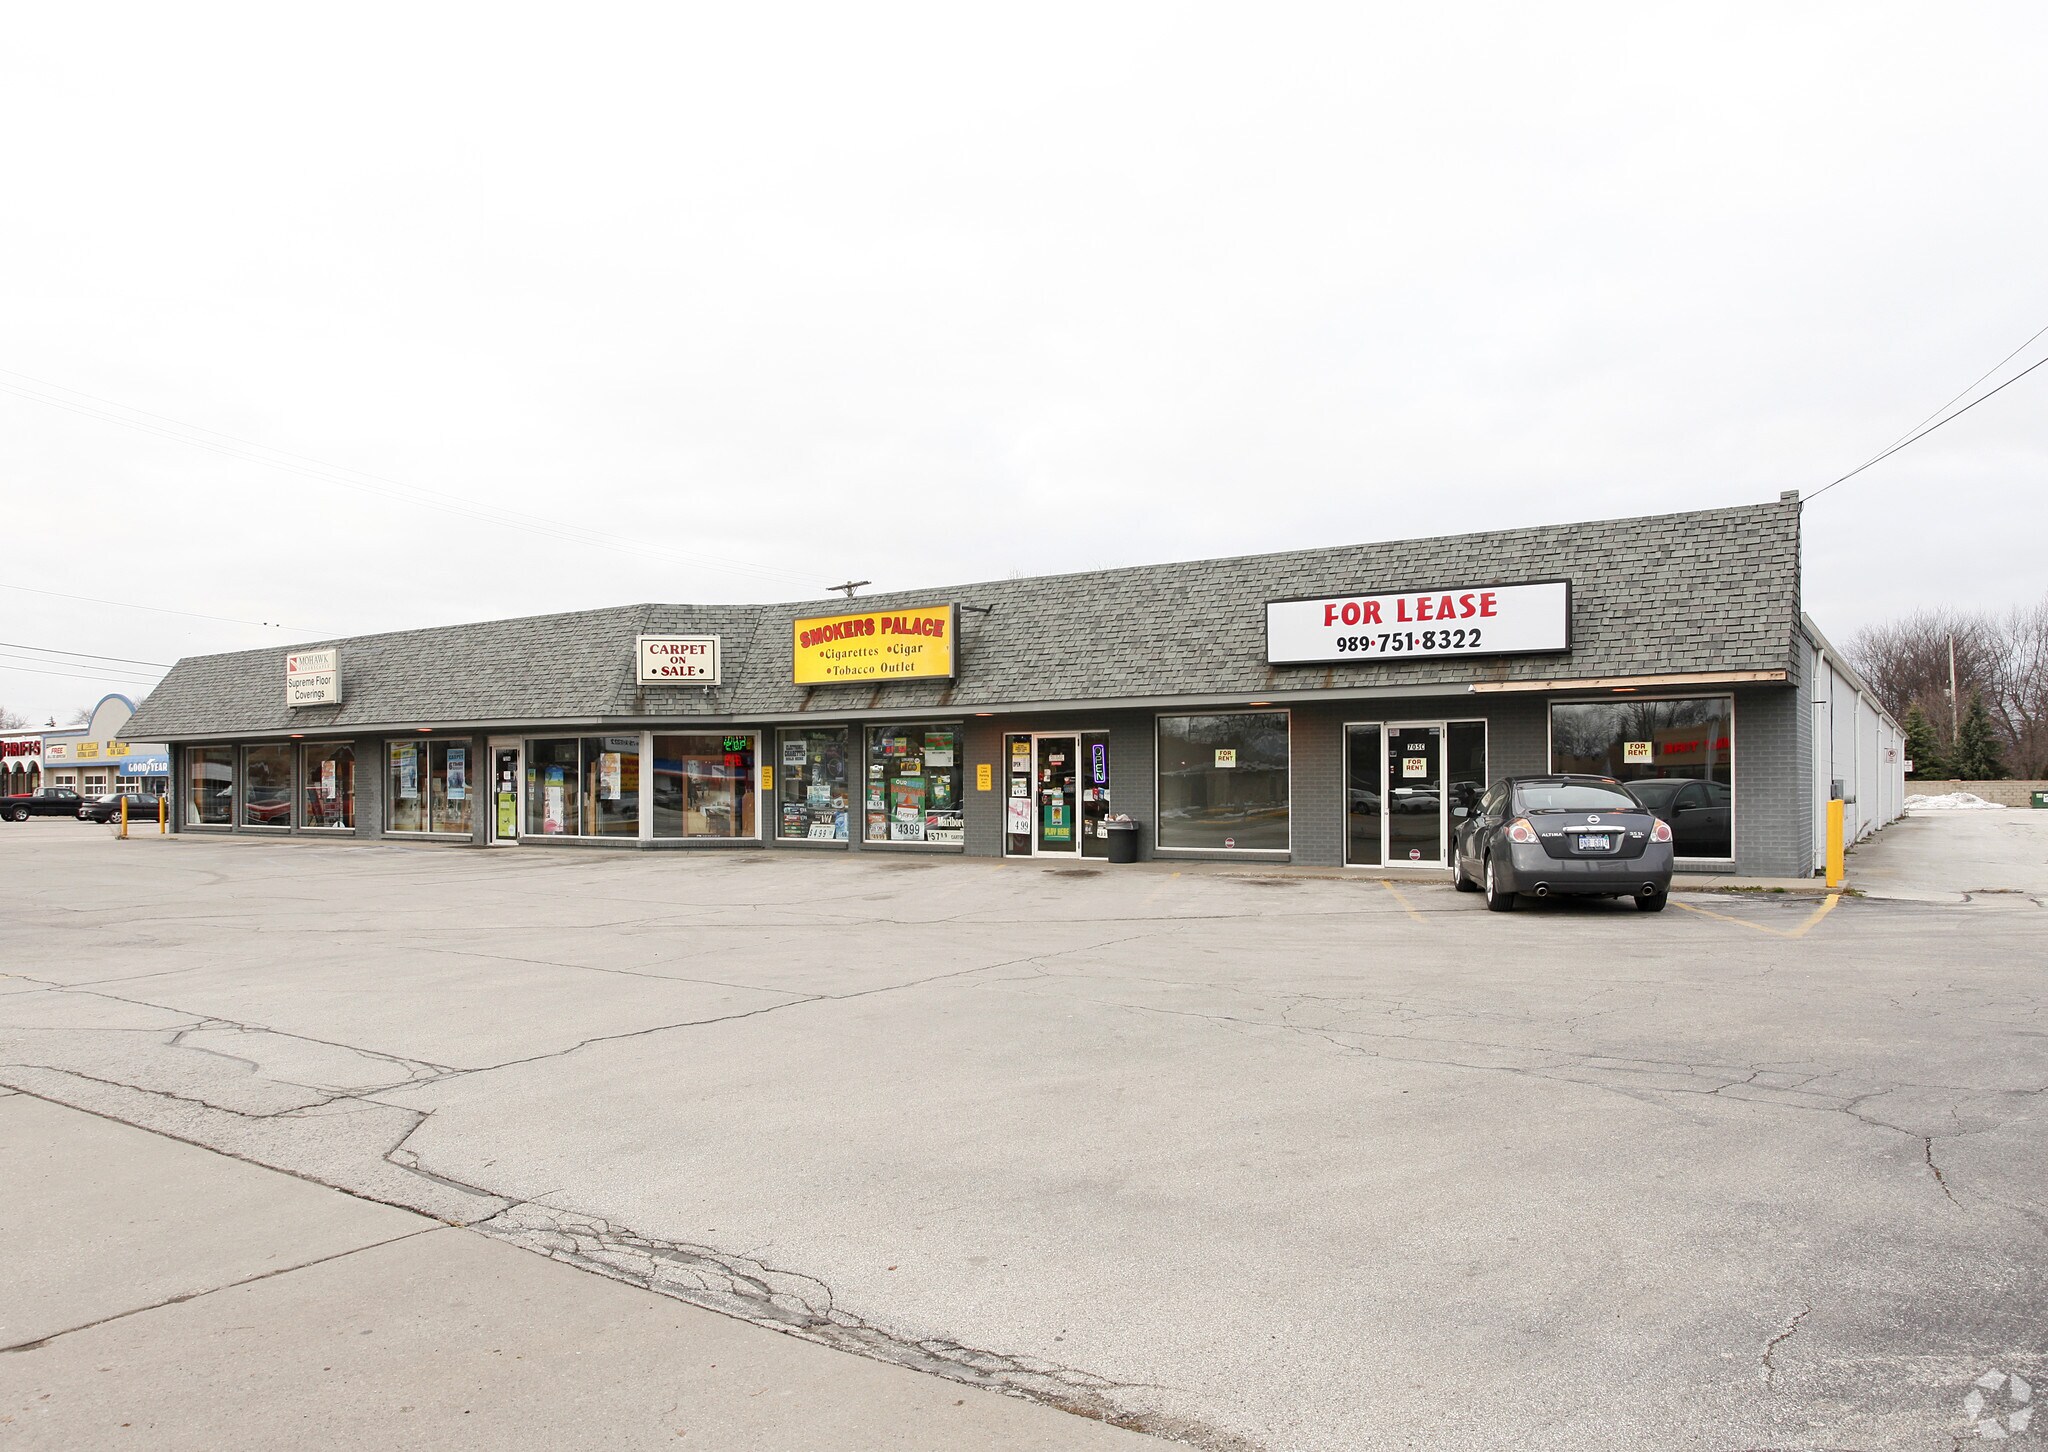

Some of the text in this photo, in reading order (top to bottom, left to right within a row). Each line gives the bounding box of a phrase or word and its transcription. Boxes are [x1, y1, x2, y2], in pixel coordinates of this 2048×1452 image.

[1323, 592, 1497, 626] FOR LEASE
[800, 616, 945, 648] SMOKERS PALACE
[649, 643, 707, 655] CARPET
[299, 654, 329, 665] MOHAWK
[669, 656, 686, 664] ON
[660, 666, 696, 676] SALE
[880, 661, 915, 673] Outlet
[288, 675, 331, 689] Supreme Floor
[295, 689, 325, 700] Coverings
[128, 761, 168, 773] GOODYEAR
[1094, 746, 1104, 780] OPEN
[1045, 827, 1069, 836] PLAY HERE
